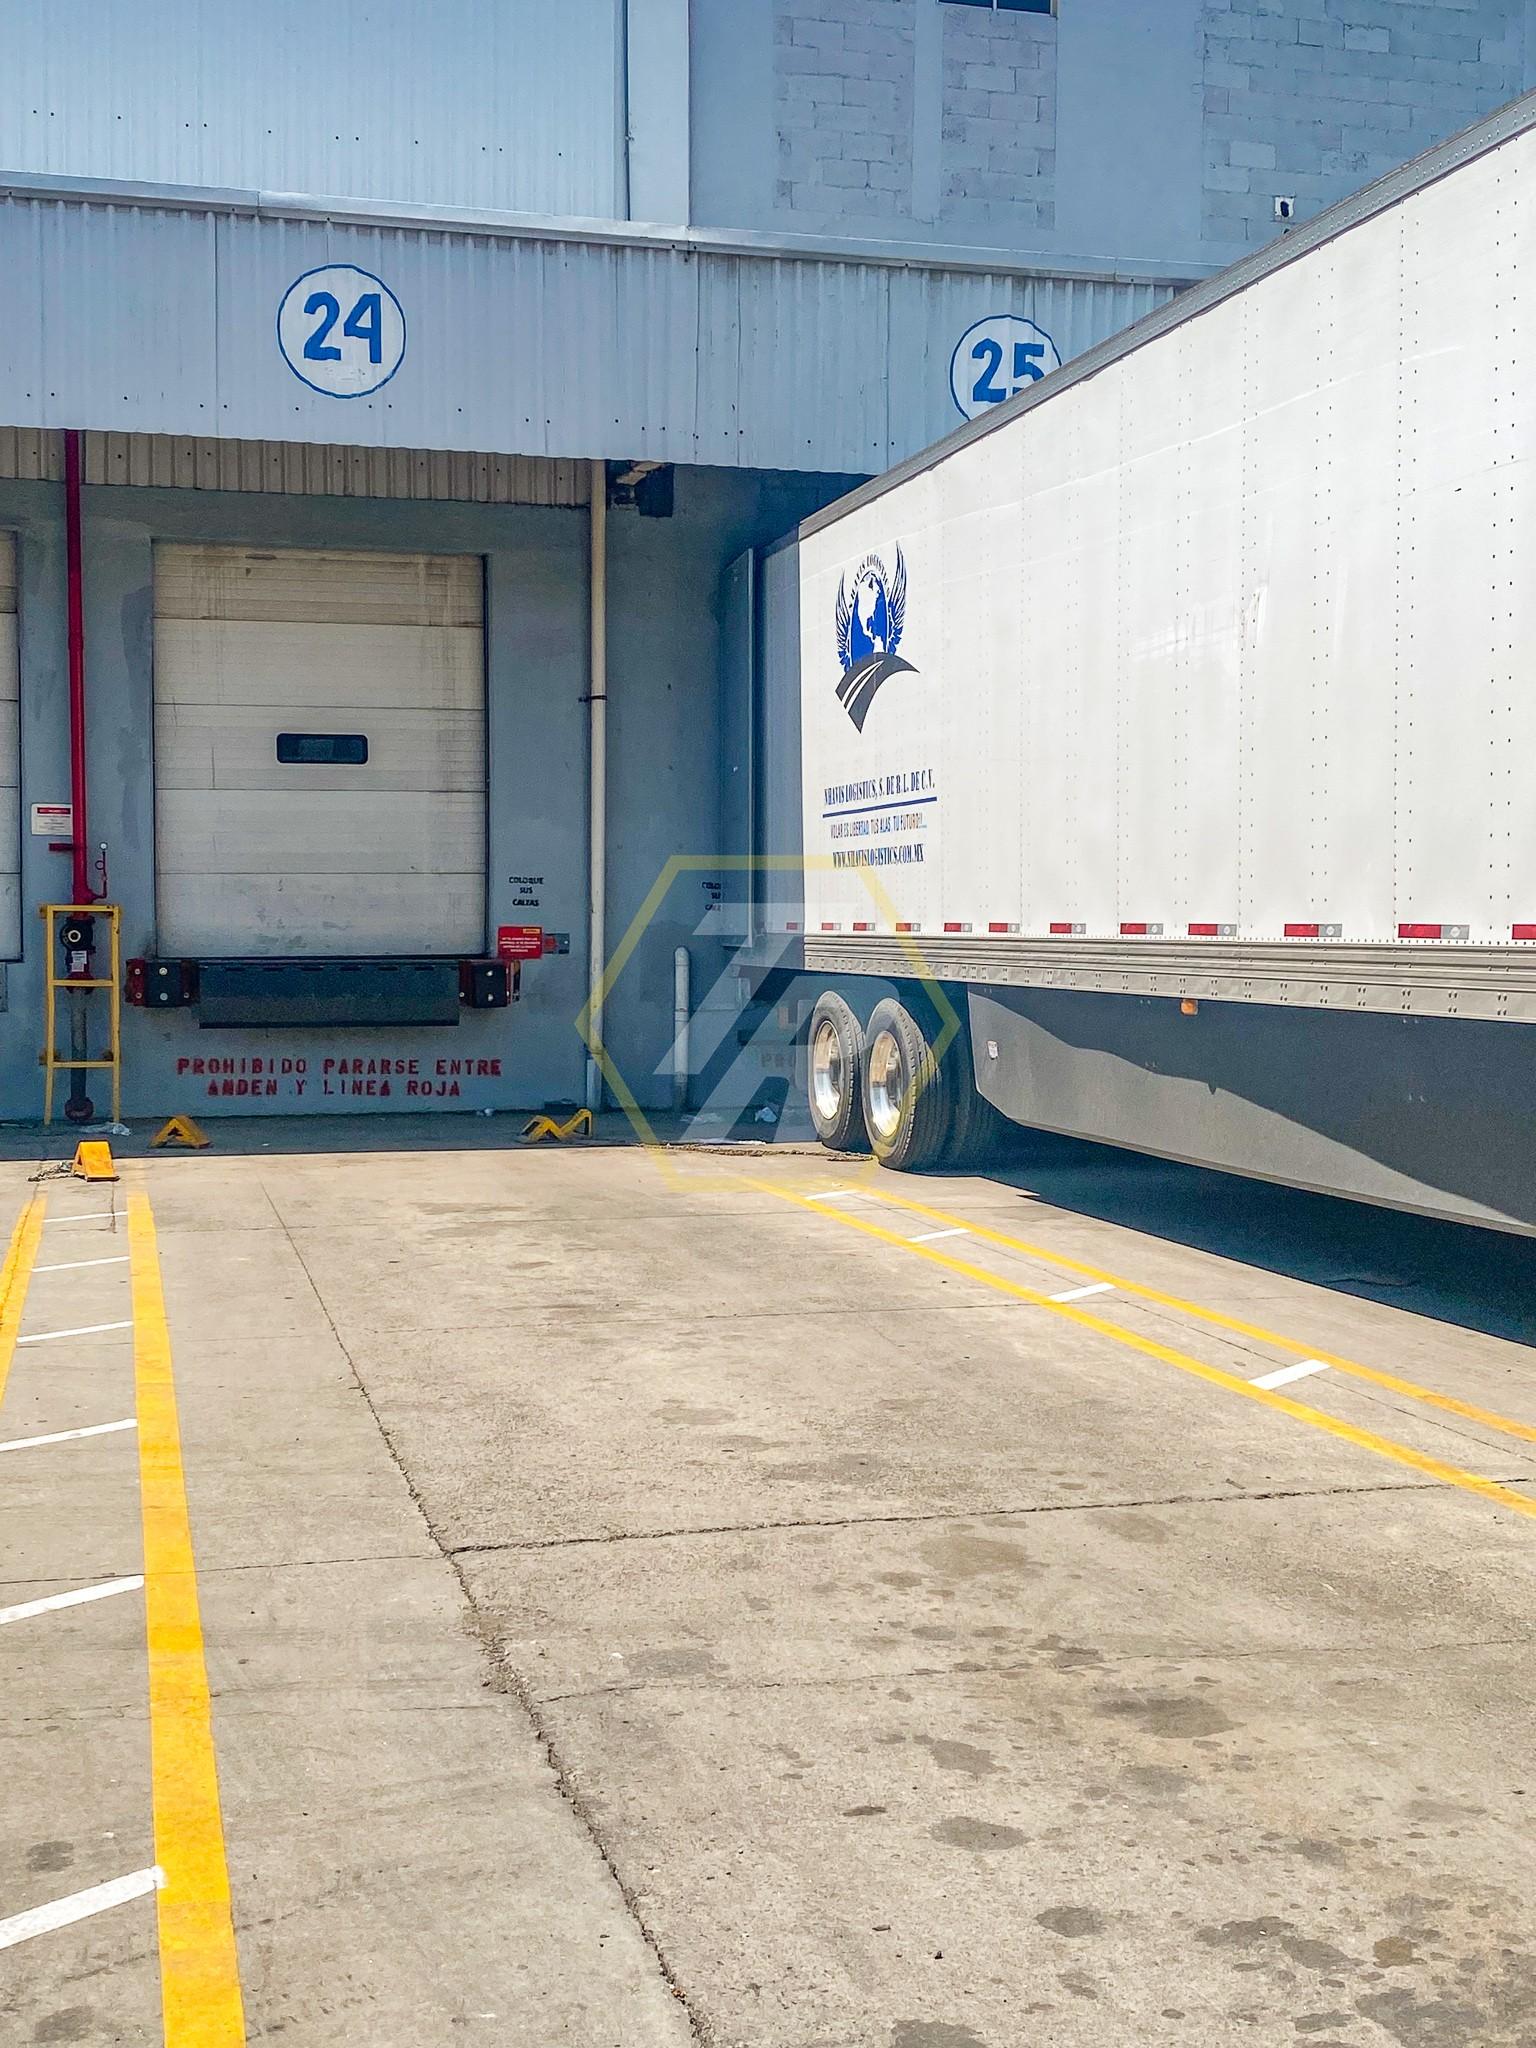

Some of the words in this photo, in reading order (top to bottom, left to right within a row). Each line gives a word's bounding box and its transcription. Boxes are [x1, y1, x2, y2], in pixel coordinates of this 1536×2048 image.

[304, 291, 383, 364] 24
[971, 338, 1045, 403] 25
[846, 778, 877, 803] LOGISTICS,
[886, 775, 895, 796] DE
[911, 771, 920, 792] DE
[508, 876, 544, 885] COLOQUE
[519, 886, 533, 894] SUS
[512, 898, 540, 907] CALZAS
[176, 1058, 307, 1075] PROHIBIDO
[323, 1058, 420, 1075] PARARSE
[435, 1058, 503, 1077] ENTRE
[207, 1079, 278, 1096] ANDEN
[295, 1079, 307, 1095] Y
[323, 1079, 391, 1097] LINEA
[406, 1080, 461, 1097] ROJA
